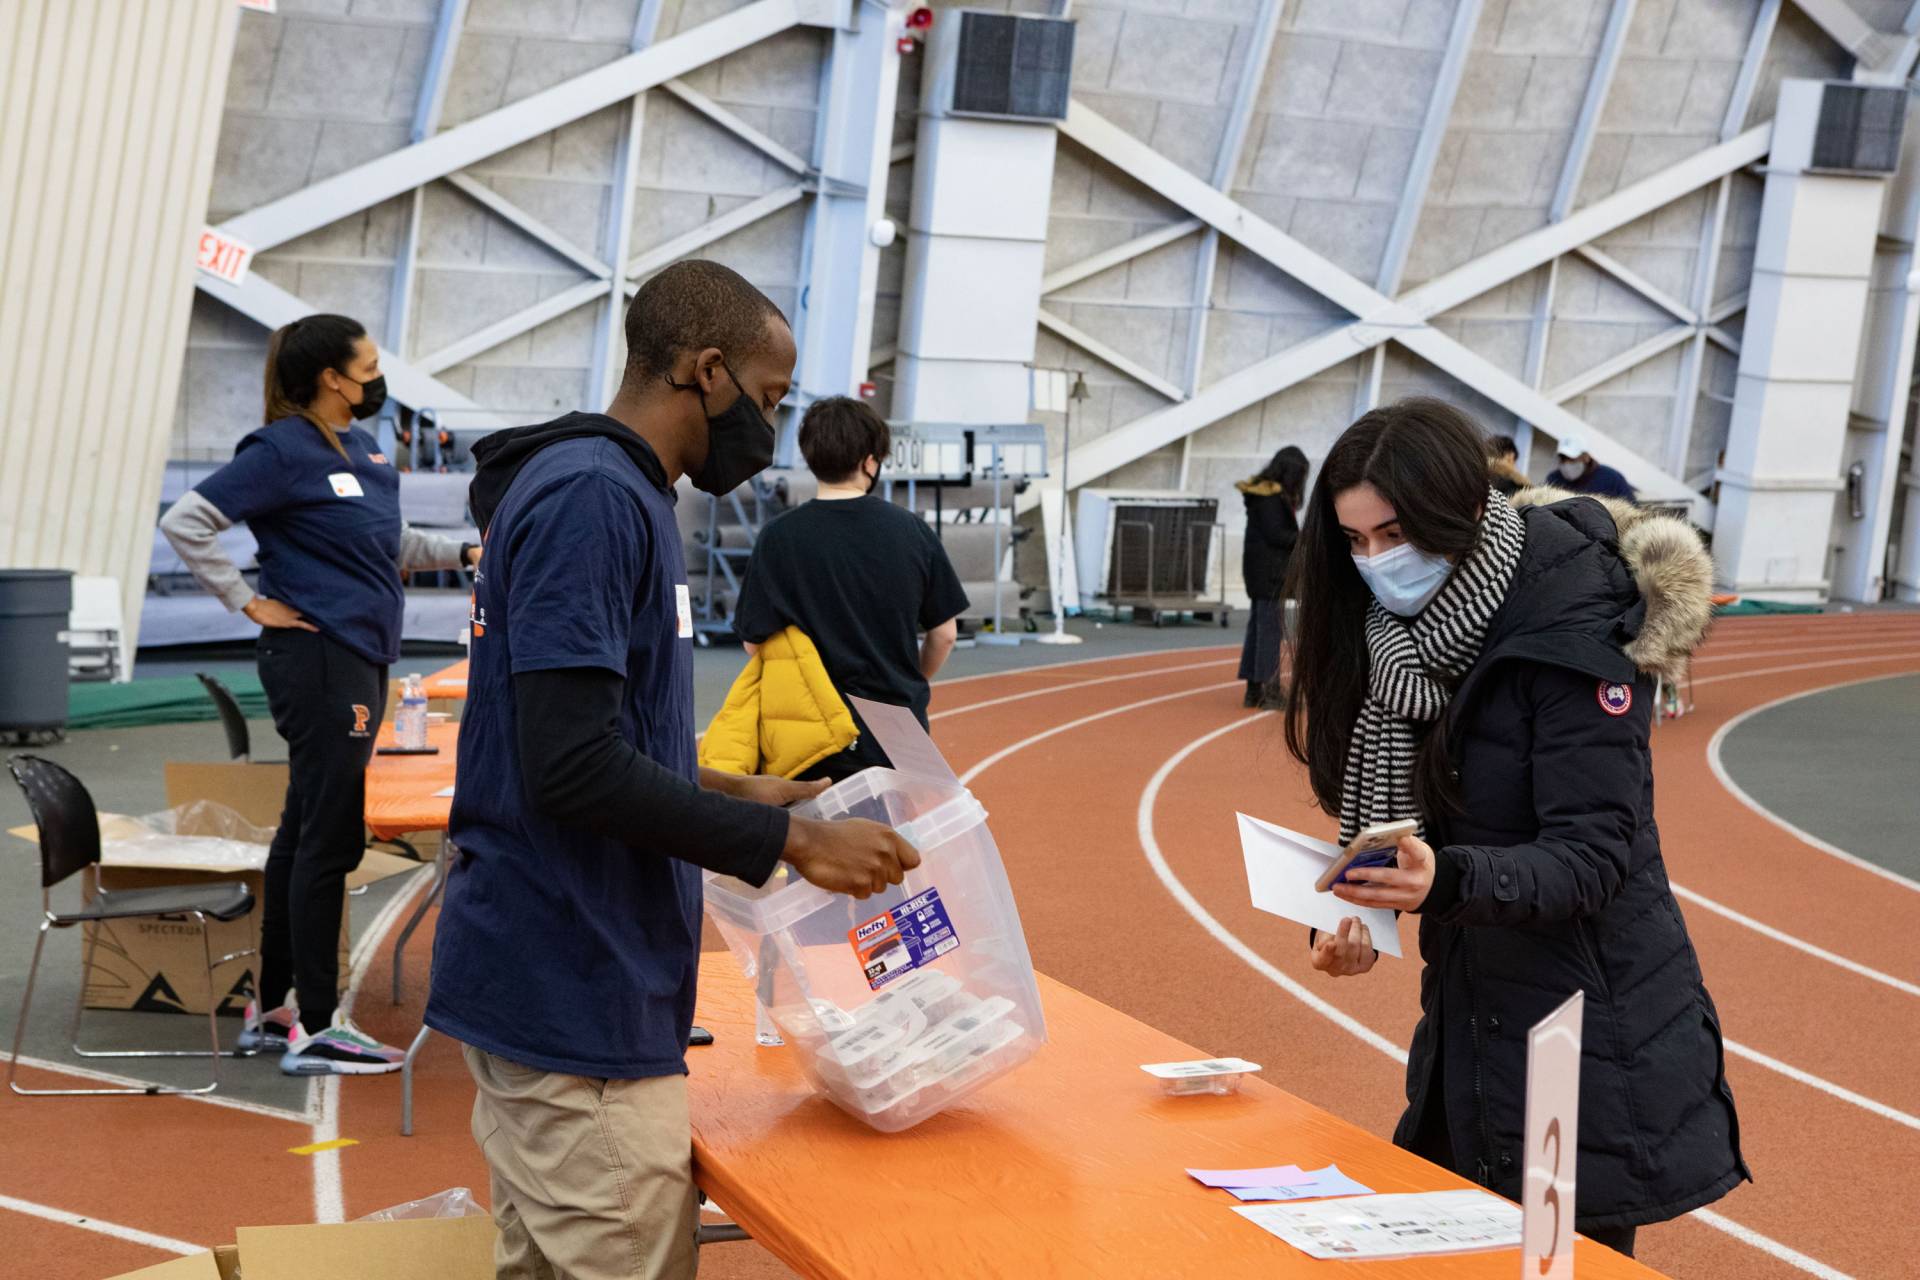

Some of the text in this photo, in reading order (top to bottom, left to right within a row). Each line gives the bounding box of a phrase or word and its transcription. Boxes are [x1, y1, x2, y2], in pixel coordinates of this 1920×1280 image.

[197, 232, 246, 279] EXIT
[351, 703, 370, 732] P
[857, 919, 886, 938] Hefty
[1539, 1116, 1561, 1276] 3
